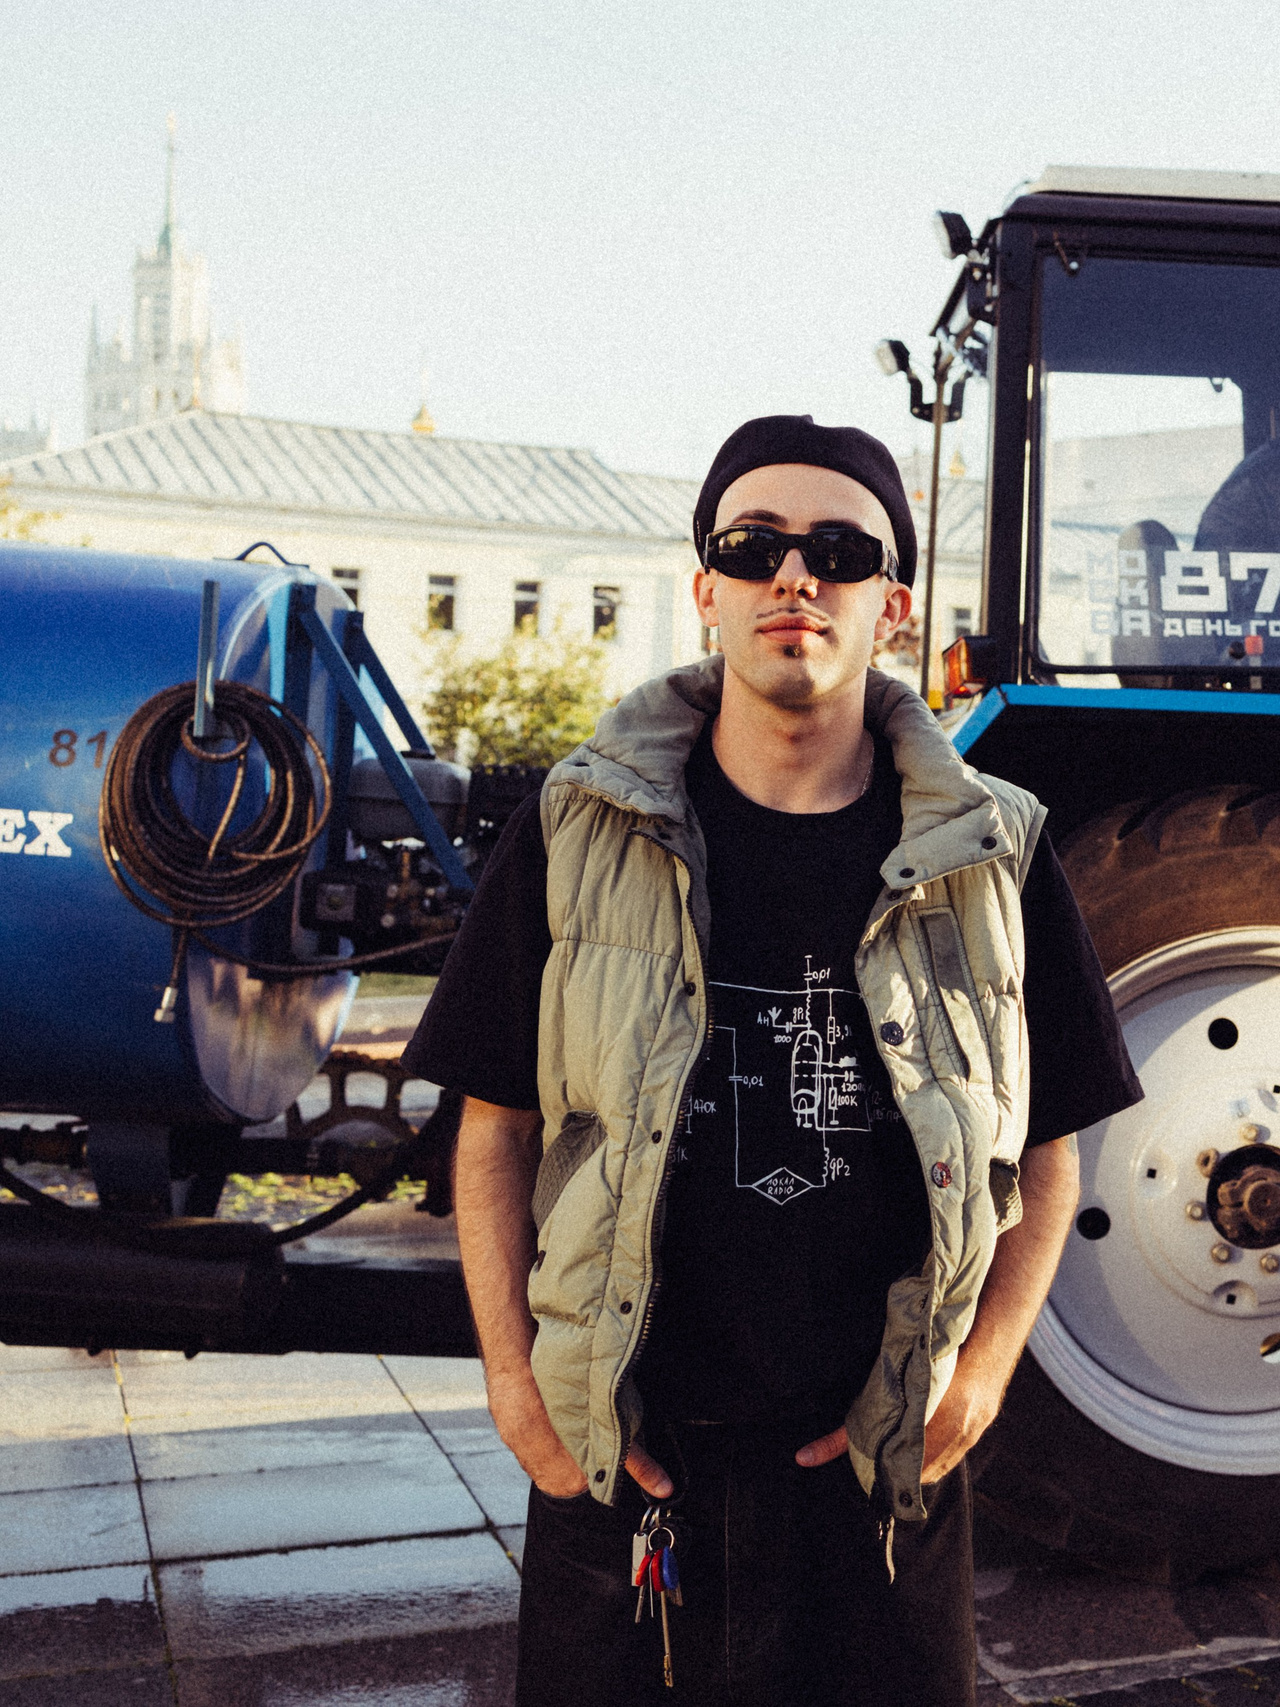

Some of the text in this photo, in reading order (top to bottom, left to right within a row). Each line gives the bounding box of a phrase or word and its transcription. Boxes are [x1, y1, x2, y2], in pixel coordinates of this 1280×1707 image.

[1163, 618, 1243, 637] ДЕНЬ
[48, 728, 108, 769] 81
[767, 1186, 794, 1195] RADIO
